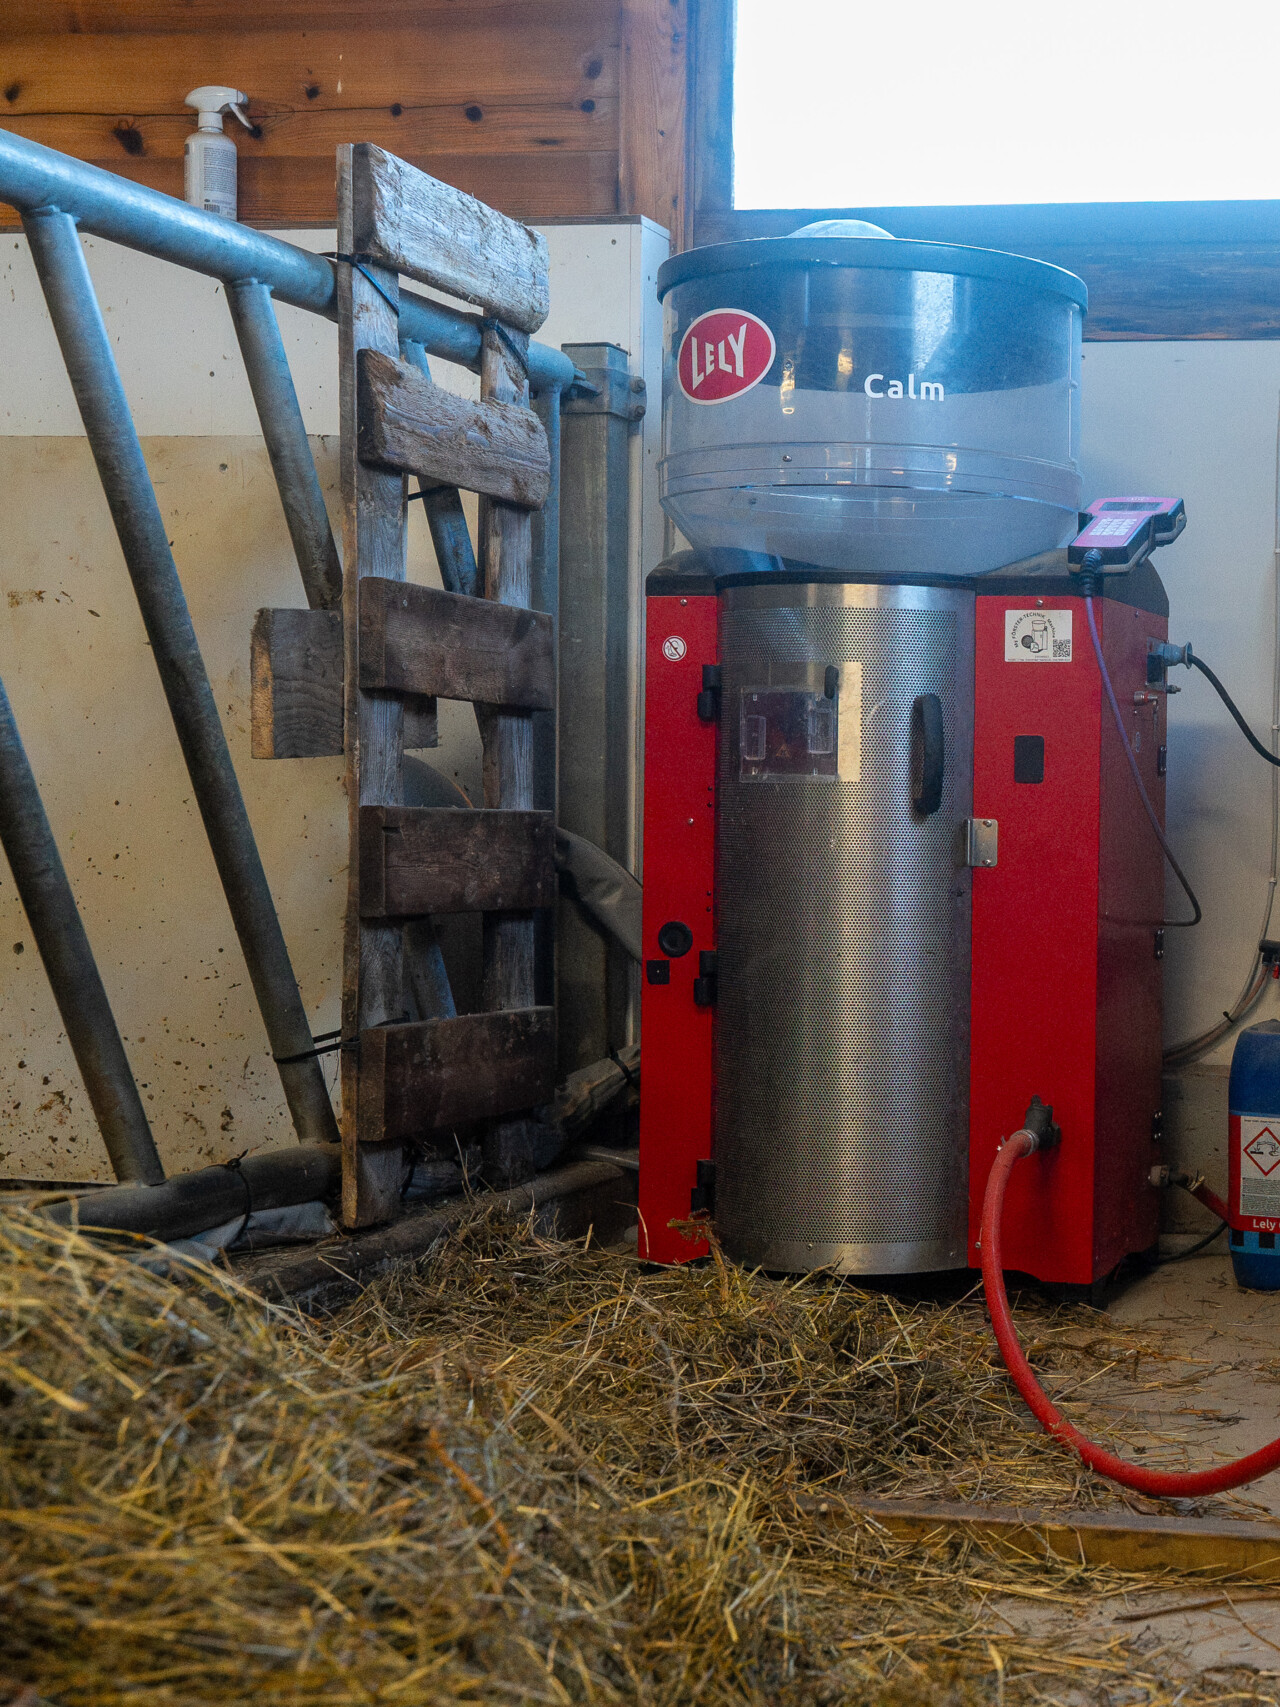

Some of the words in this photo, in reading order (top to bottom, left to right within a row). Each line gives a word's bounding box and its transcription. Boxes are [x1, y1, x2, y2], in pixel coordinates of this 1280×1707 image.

[691, 322, 747, 391] LELY
[864, 373, 944, 402] Calm
[1253, 1219, 1276, 1231] Lely
